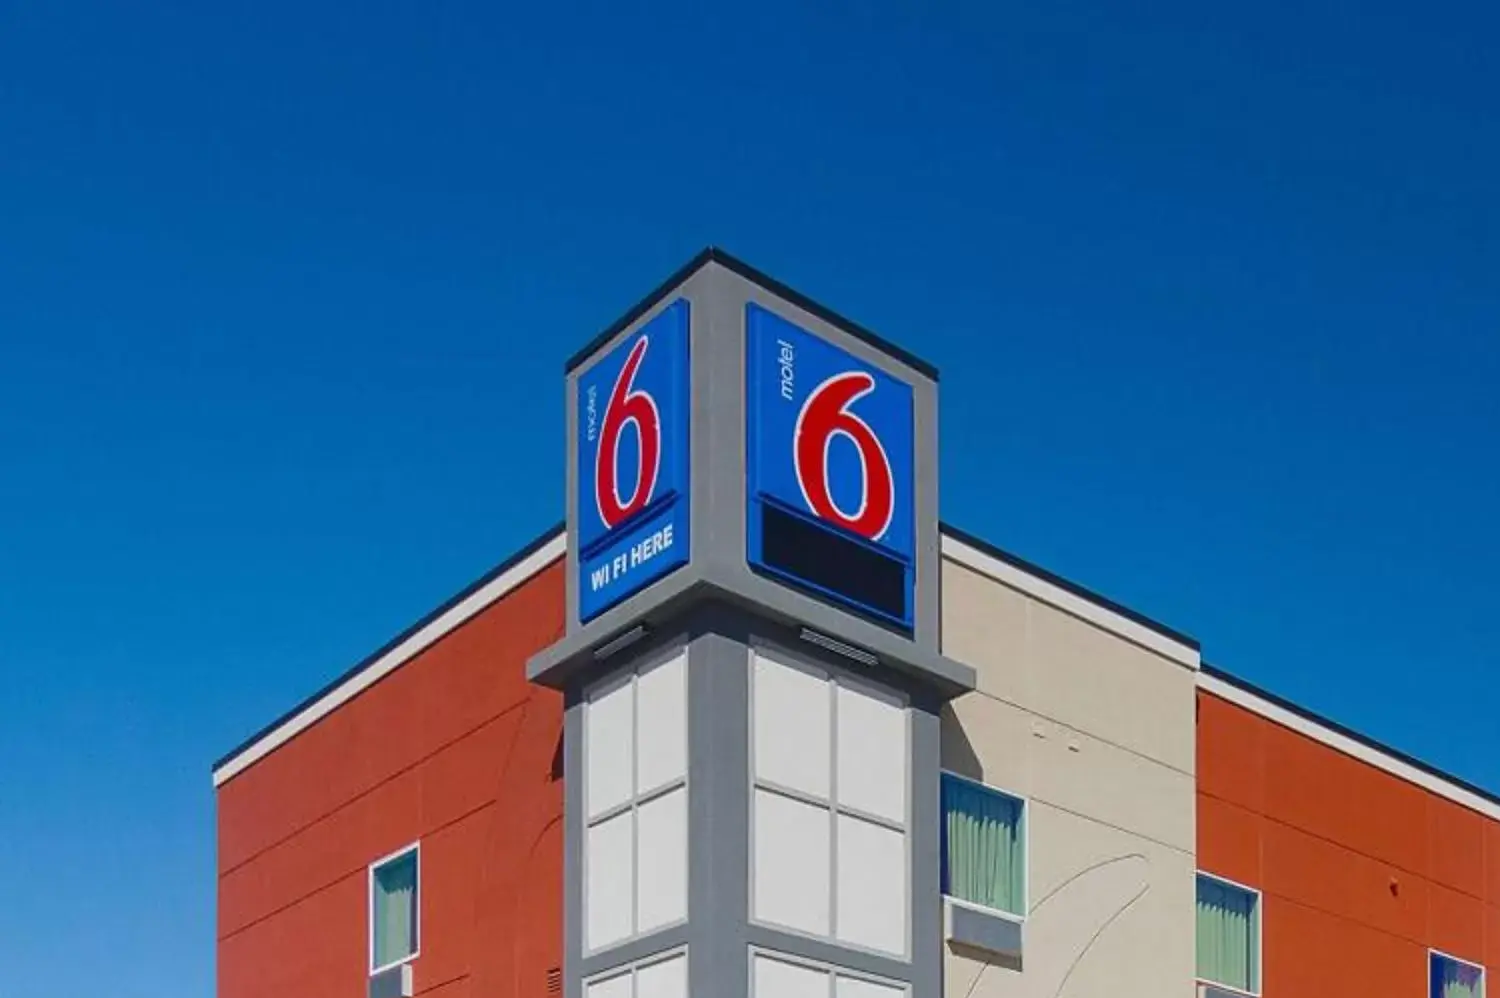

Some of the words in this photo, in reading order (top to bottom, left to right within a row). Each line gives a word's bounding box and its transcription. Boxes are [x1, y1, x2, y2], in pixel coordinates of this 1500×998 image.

[595, 334, 661, 530] 6
[777, 338, 794, 401] motel
[793, 370, 895, 542] 6
[591, 563, 609, 593] WI
[613, 552, 628, 580] FI
[631, 523, 674, 569] HERE
